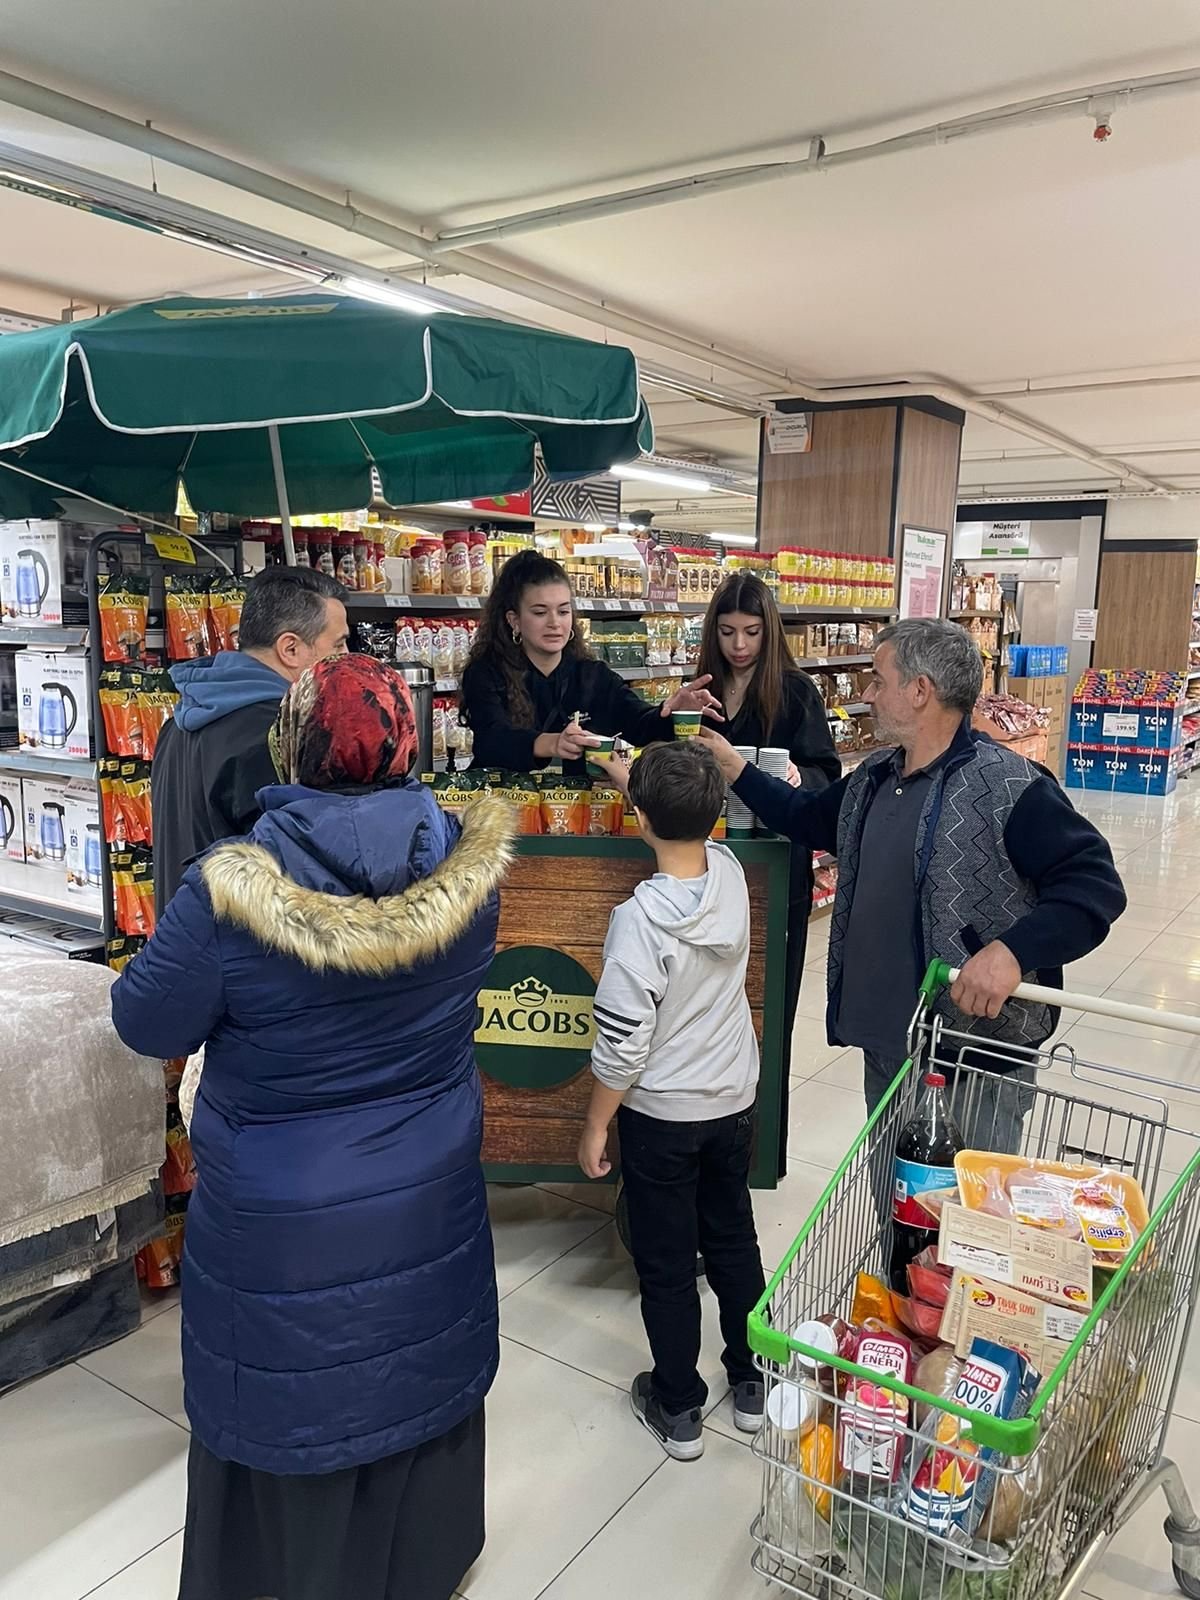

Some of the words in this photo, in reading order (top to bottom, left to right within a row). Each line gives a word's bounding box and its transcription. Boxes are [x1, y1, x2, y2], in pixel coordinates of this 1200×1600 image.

[993, 522, 1021, 531] Müşteri
[221, 593, 246, 604] JACO
[1075, 713, 1097, 722] TON
[1143, 716, 1167, 726] TON
[1072, 758, 1094, 768] TON
[1105, 761, 1127, 770] TON
[1138, 763, 1162, 773] TON
[435, 793, 473, 802] JACOBS
[543, 791, 580, 801] JACOBS
[591, 791, 616, 800] COBS
[477, 1006, 590, 1036] JACOBS
[954, 1379, 996, 1412] 00%
